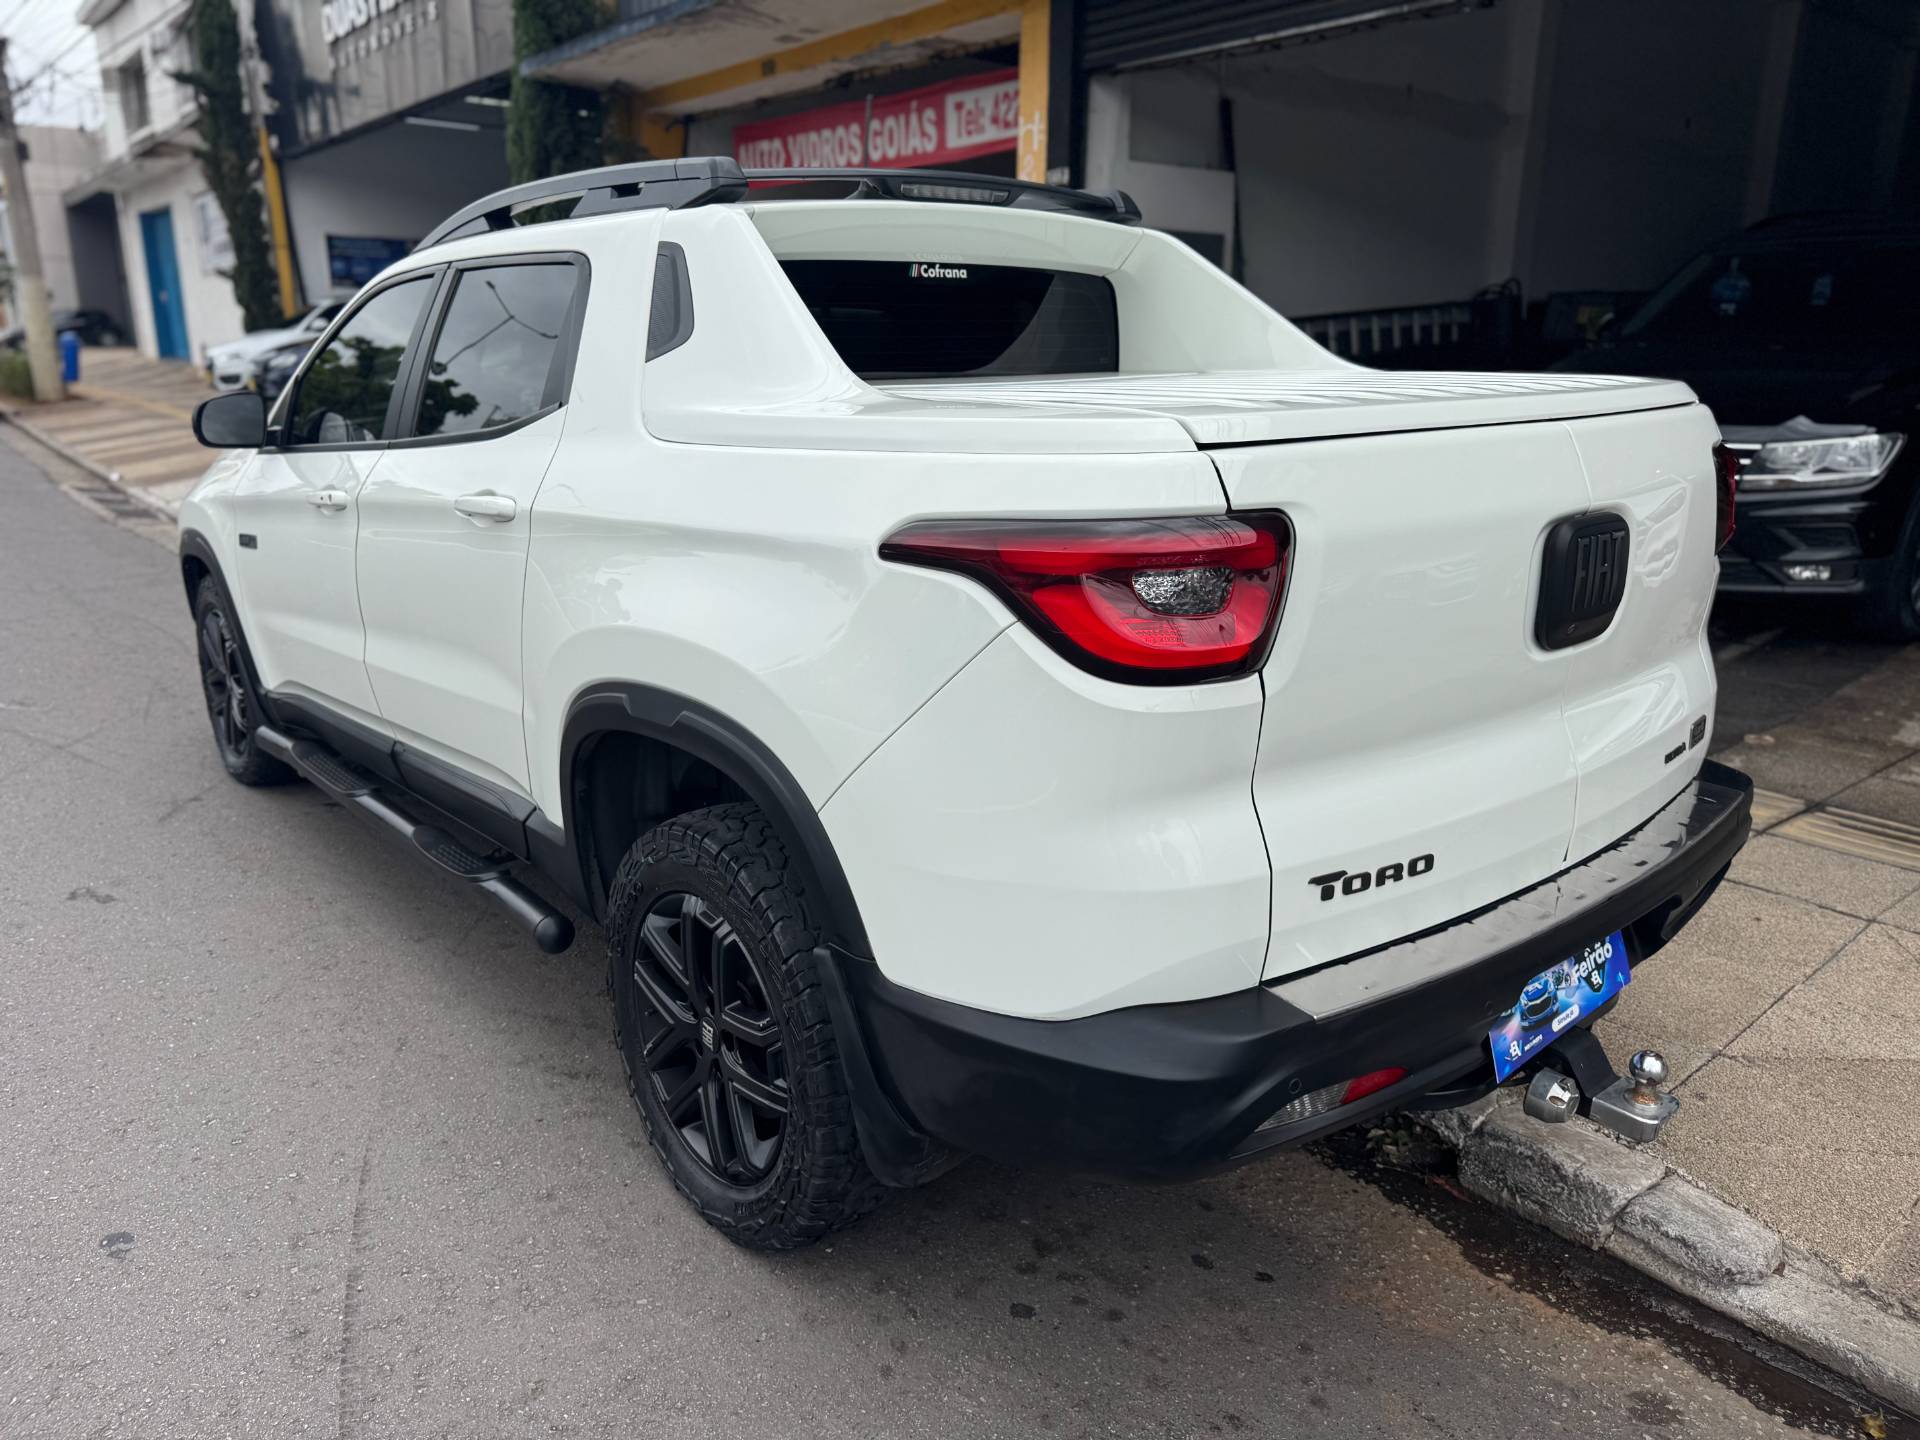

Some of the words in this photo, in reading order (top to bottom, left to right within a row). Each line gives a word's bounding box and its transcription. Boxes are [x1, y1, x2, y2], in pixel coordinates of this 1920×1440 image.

[787, 121, 863, 168] VIDROS
[867, 99, 938, 163] GOIÁS
[920, 263, 968, 279] Cofrana
[1571, 530, 1625, 613] FIAT
[1307, 853, 1435, 902] TORO
[1572, 941, 1613, 985] Feirão
